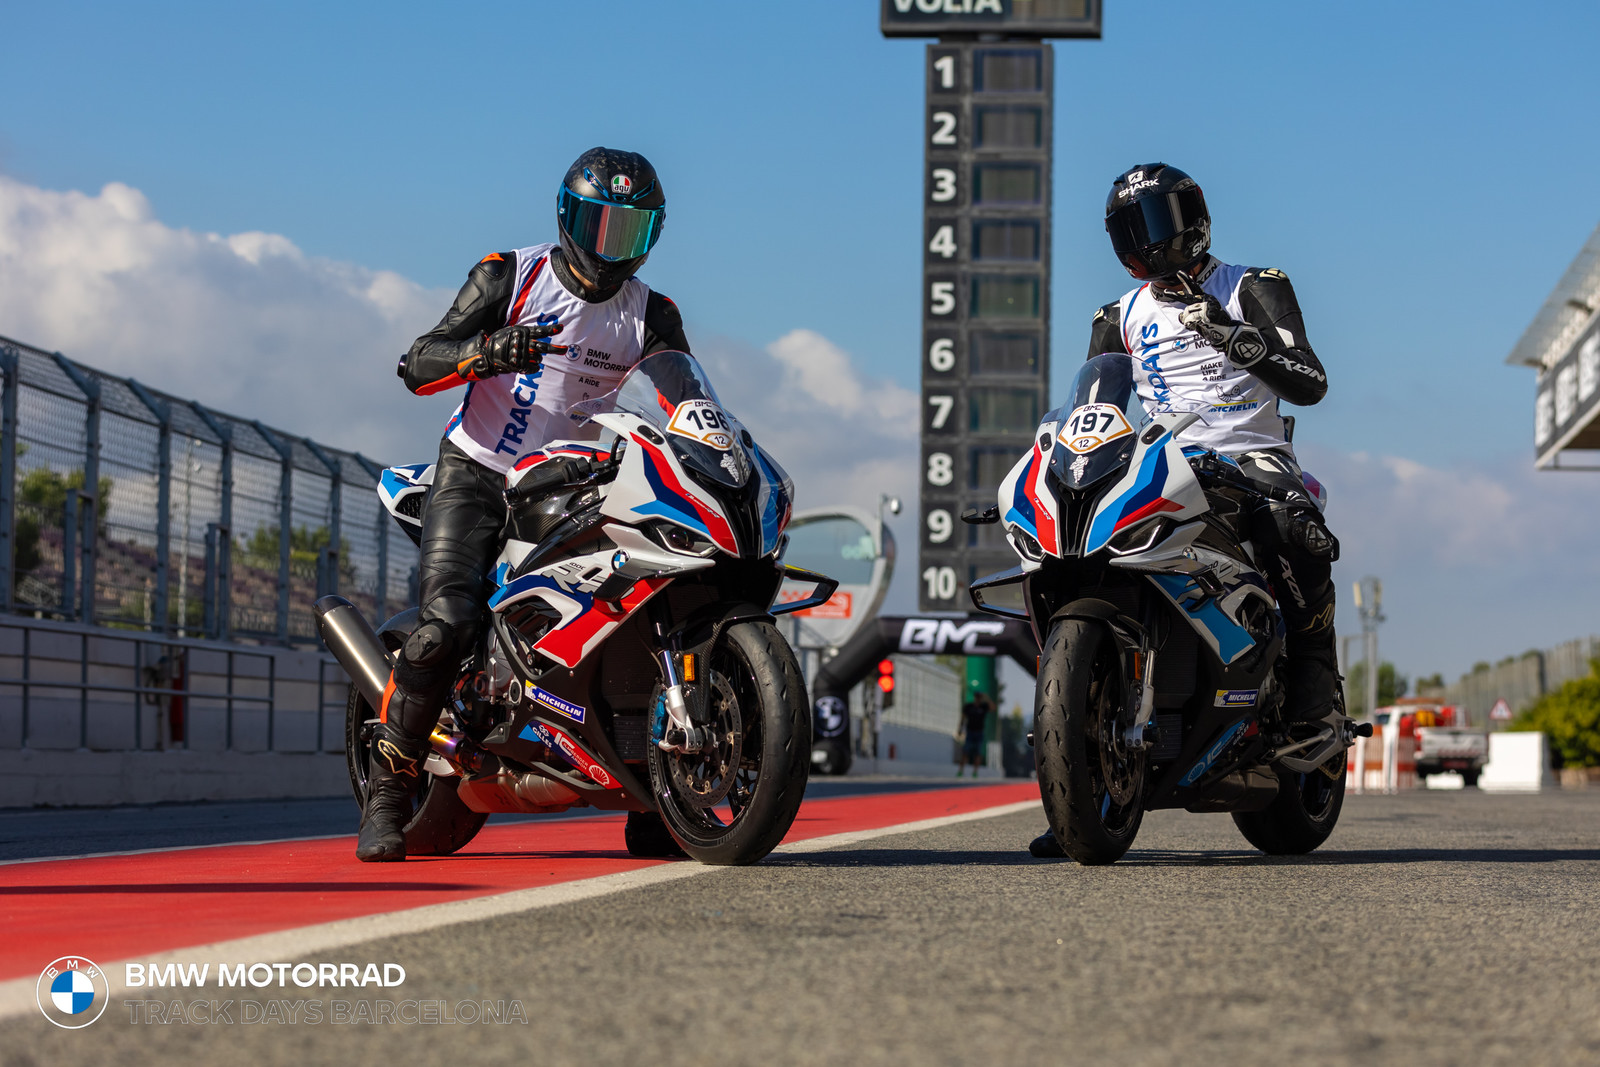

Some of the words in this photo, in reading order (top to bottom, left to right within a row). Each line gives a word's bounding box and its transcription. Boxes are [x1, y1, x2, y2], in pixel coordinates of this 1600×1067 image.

[934, 56, 955, 88] 1
[931, 112, 957, 145] 2
[931, 169, 957, 202] 3
[1118, 178, 1160, 198] SHARK
[929, 225, 957, 259] 4
[931, 282, 956, 315] 5
[586, 348, 611, 360] BMW
[929, 338, 955, 372] 6
[1200, 361, 1223, 371] MAKE
[585, 378, 600, 387] RIDE
[928, 396, 954, 429] 7
[1069, 412, 1115, 436] 197
[714, 436, 726, 445] 12
[1078, 439, 1089, 448] 12
[927, 452, 953, 486] 8
[927, 509, 953, 543] 9
[923, 566, 956, 600] 10
[900, 618, 1005, 654] BMC
[538, 692, 582, 716] MICHELIN
[1227, 694, 1257, 702] MICHELIN
[532, 727, 552, 748] GILLES
